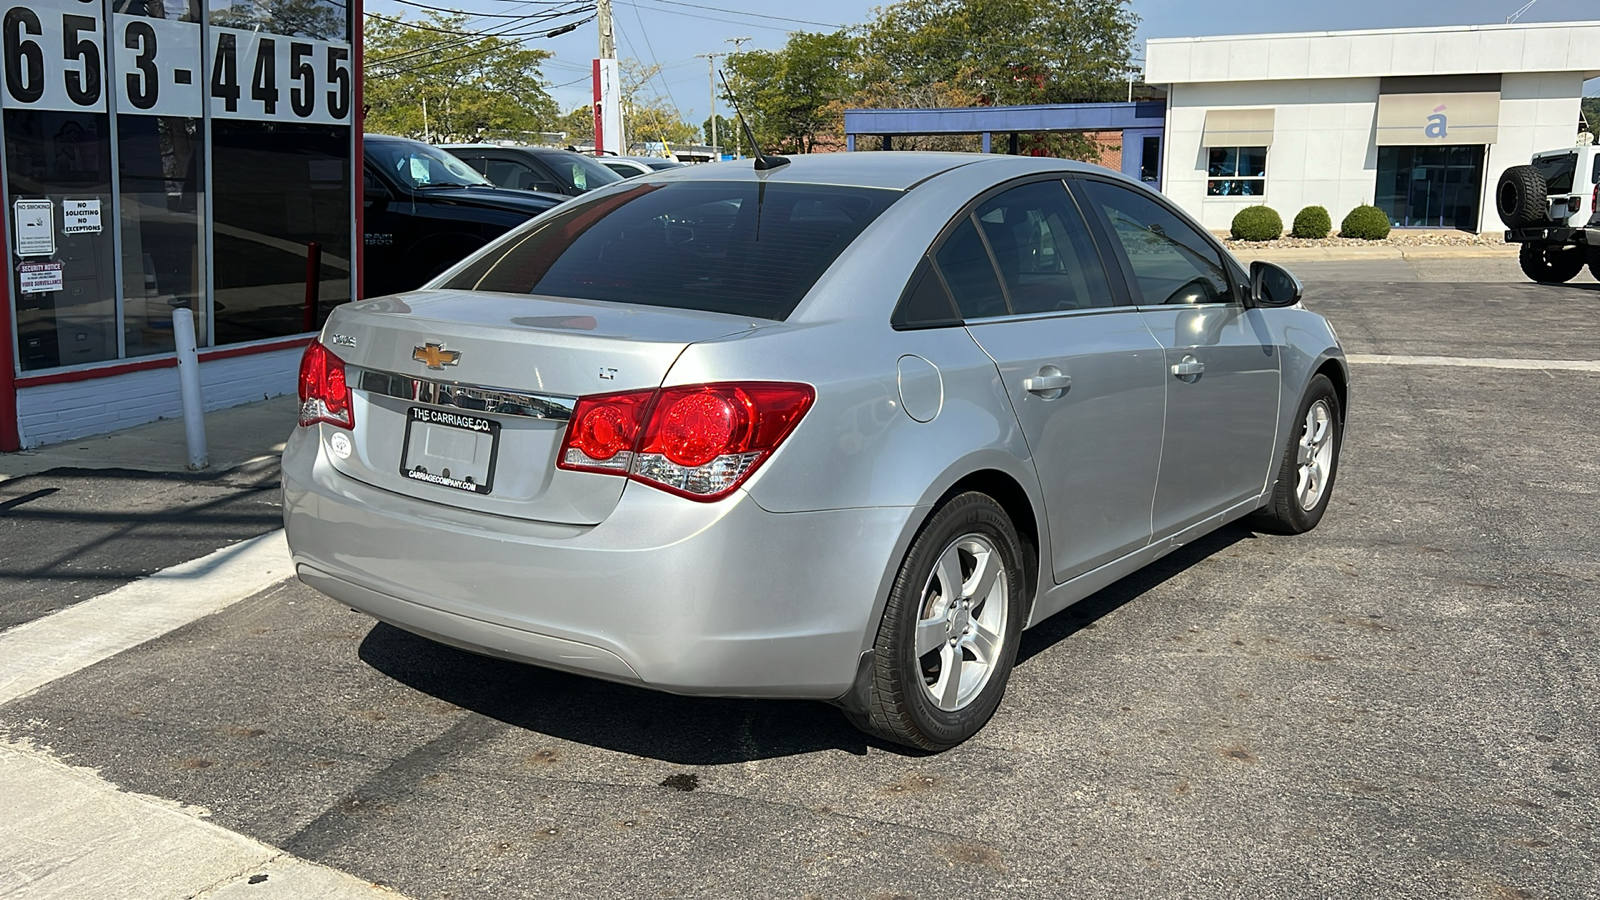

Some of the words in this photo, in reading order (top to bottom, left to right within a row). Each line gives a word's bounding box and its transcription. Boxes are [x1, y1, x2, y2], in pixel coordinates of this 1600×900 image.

[2, 6, 351, 120] 653-4455
[21, 264, 44, 272] SECURITY
[34, 279, 62, 287] SURVEILLANCE
[599, 367, 618, 380] LT
[413, 408, 430, 420] THE
[431, 411, 474, 427] CARRIAGE
[475, 419, 491, 432] CO.
[408, 470, 477, 492] CARRIAGECOMPANY.COM
